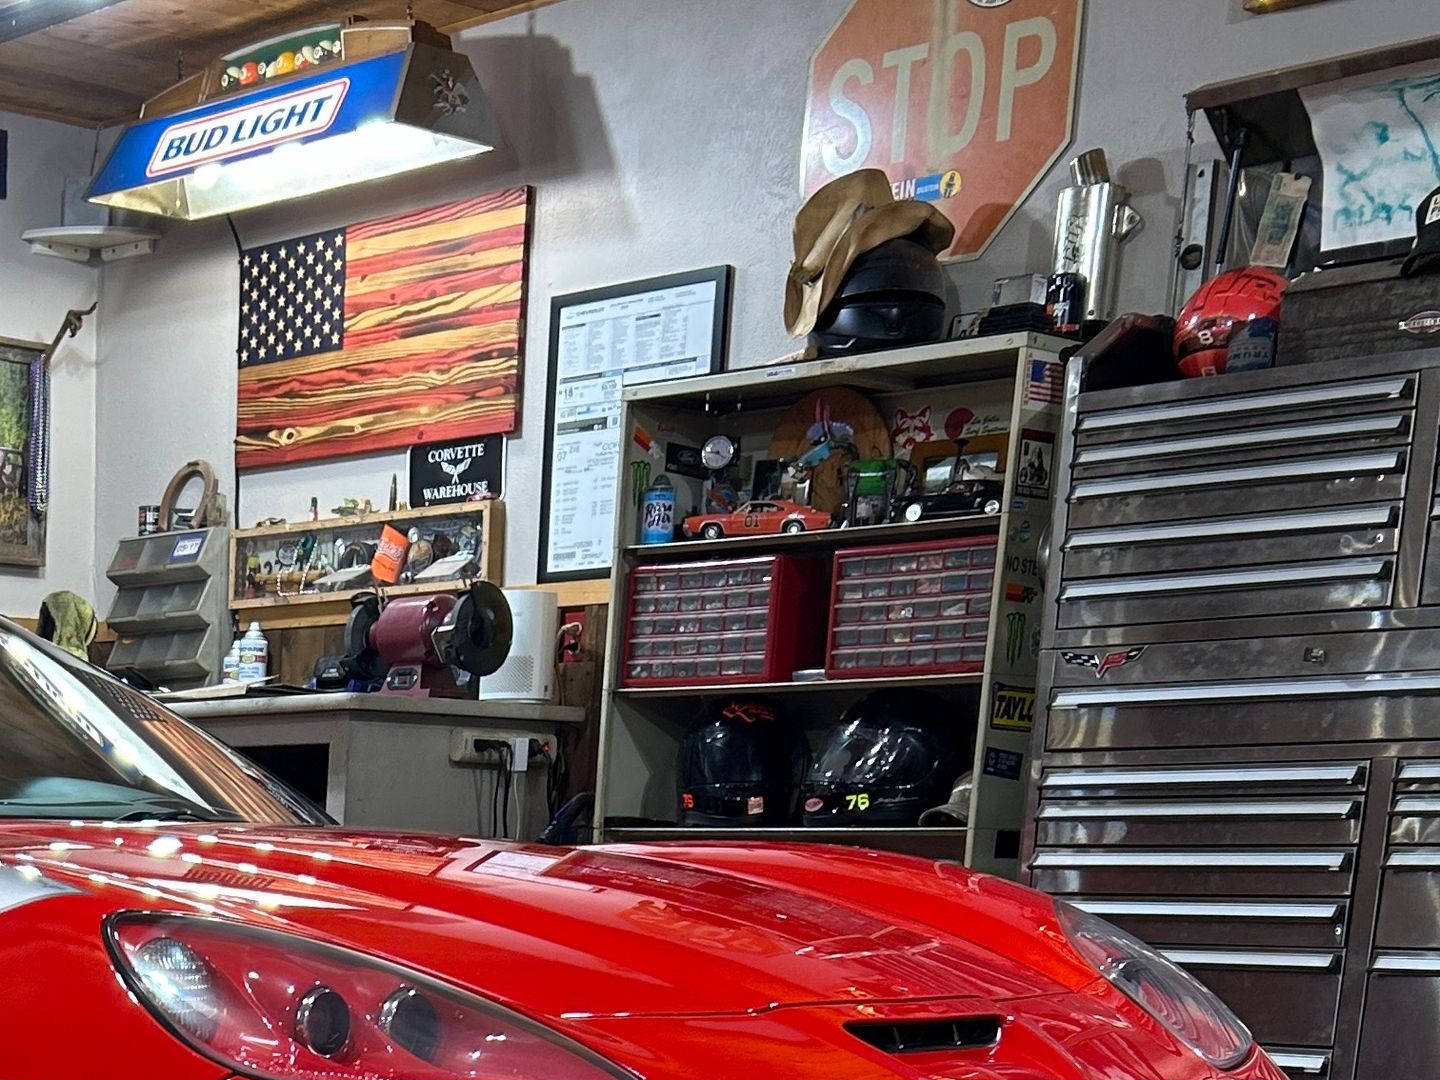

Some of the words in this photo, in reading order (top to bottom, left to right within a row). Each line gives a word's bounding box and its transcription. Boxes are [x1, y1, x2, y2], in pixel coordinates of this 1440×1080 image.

[822, 16, 1057, 178] STOP
[161, 125, 229, 162] BUD
[230, 95, 333, 144] LIGHT
[428, 443, 485, 463] CORVETTE
[422, 481, 489, 500] WAREHOUSE
[744, 515, 760, 528] 01
[1006, 555, 1020, 572] NO
[1021, 559, 1039, 577] STE
[845, 793, 870, 811] 76
